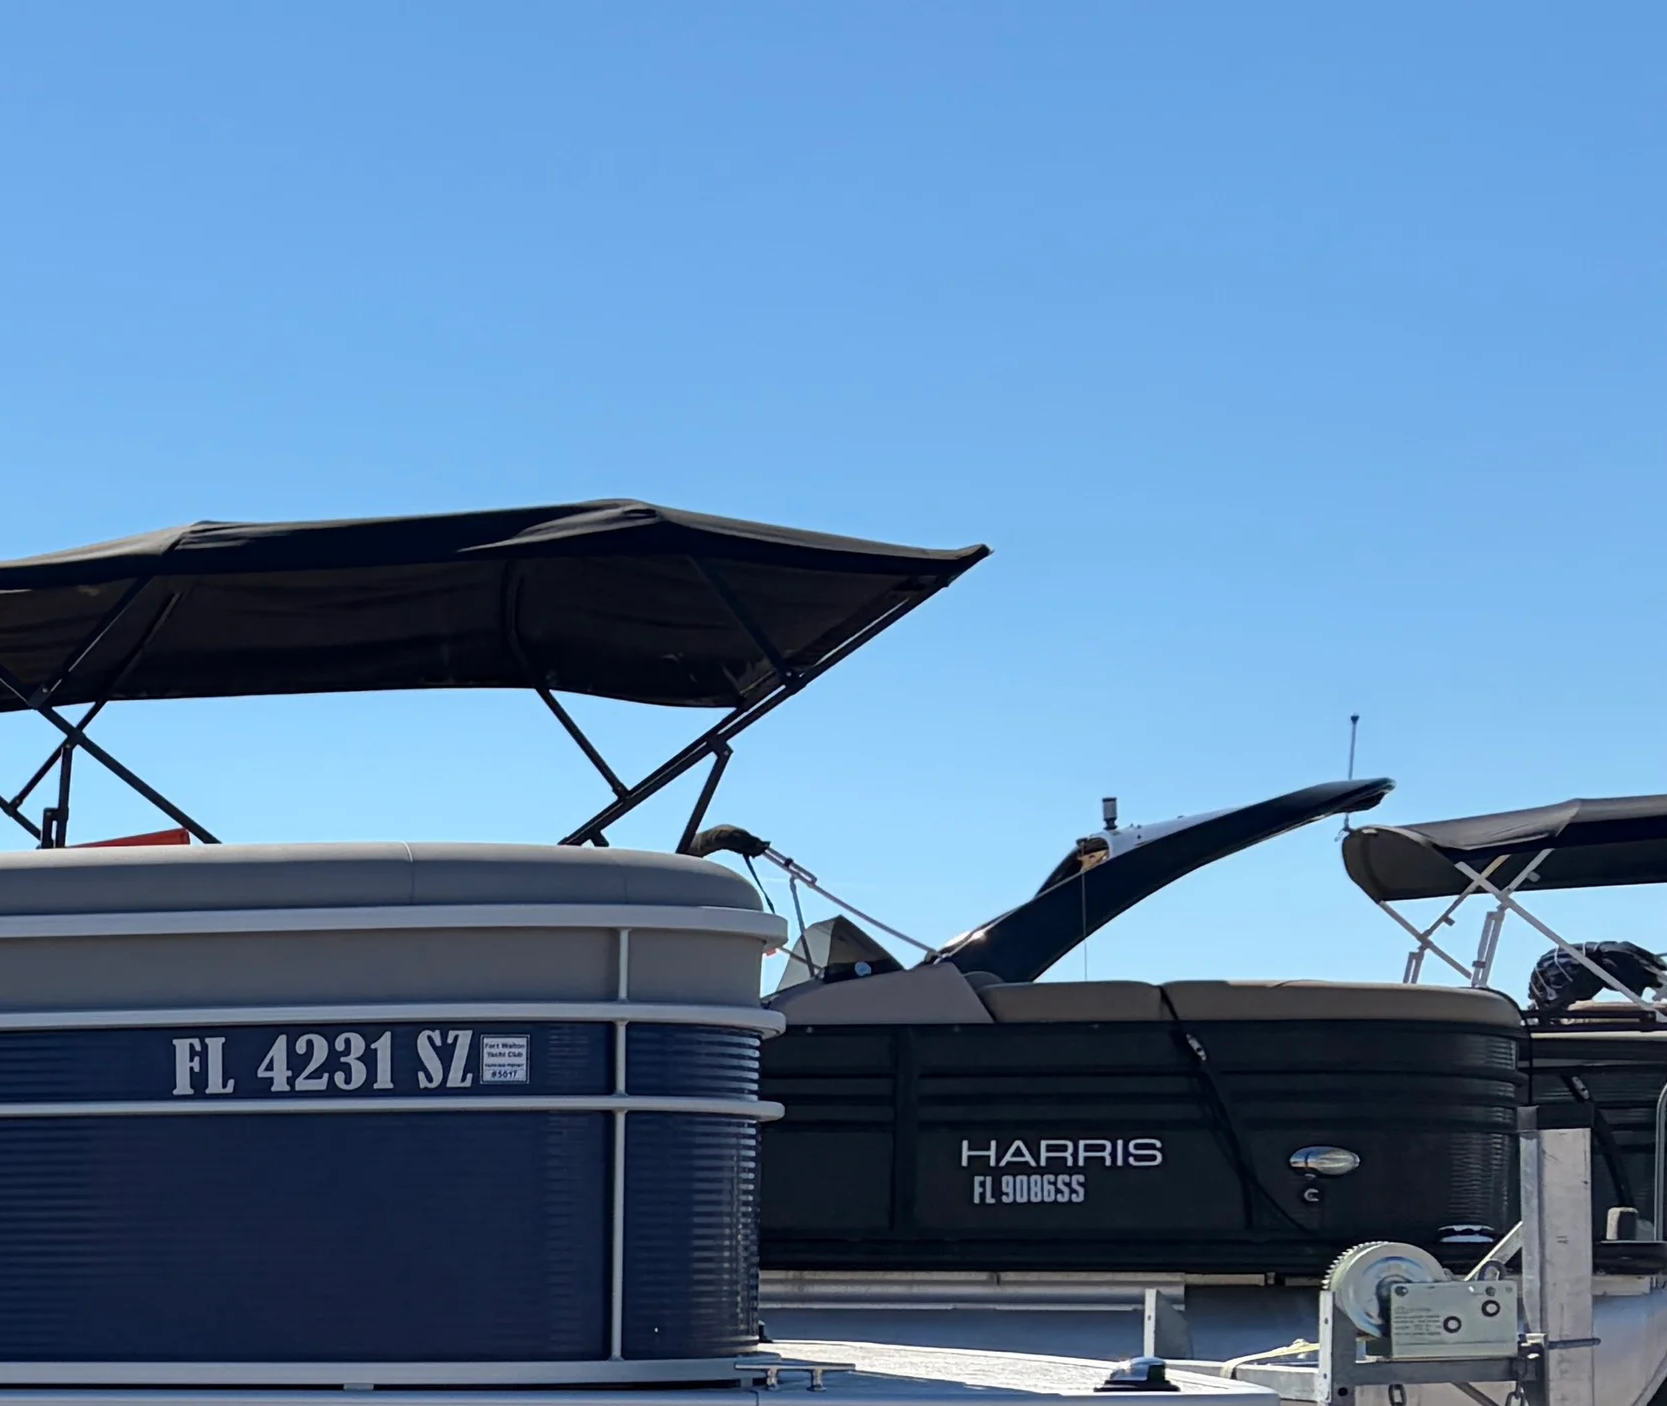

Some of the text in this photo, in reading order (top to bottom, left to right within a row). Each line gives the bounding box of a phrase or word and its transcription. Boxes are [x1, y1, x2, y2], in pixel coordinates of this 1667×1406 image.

[172, 1029, 473, 1095] FL 4231 SZ
[961, 1138, 1163, 1167] HARRIS
[973, 1174, 1085, 1204] FL 9086SS
